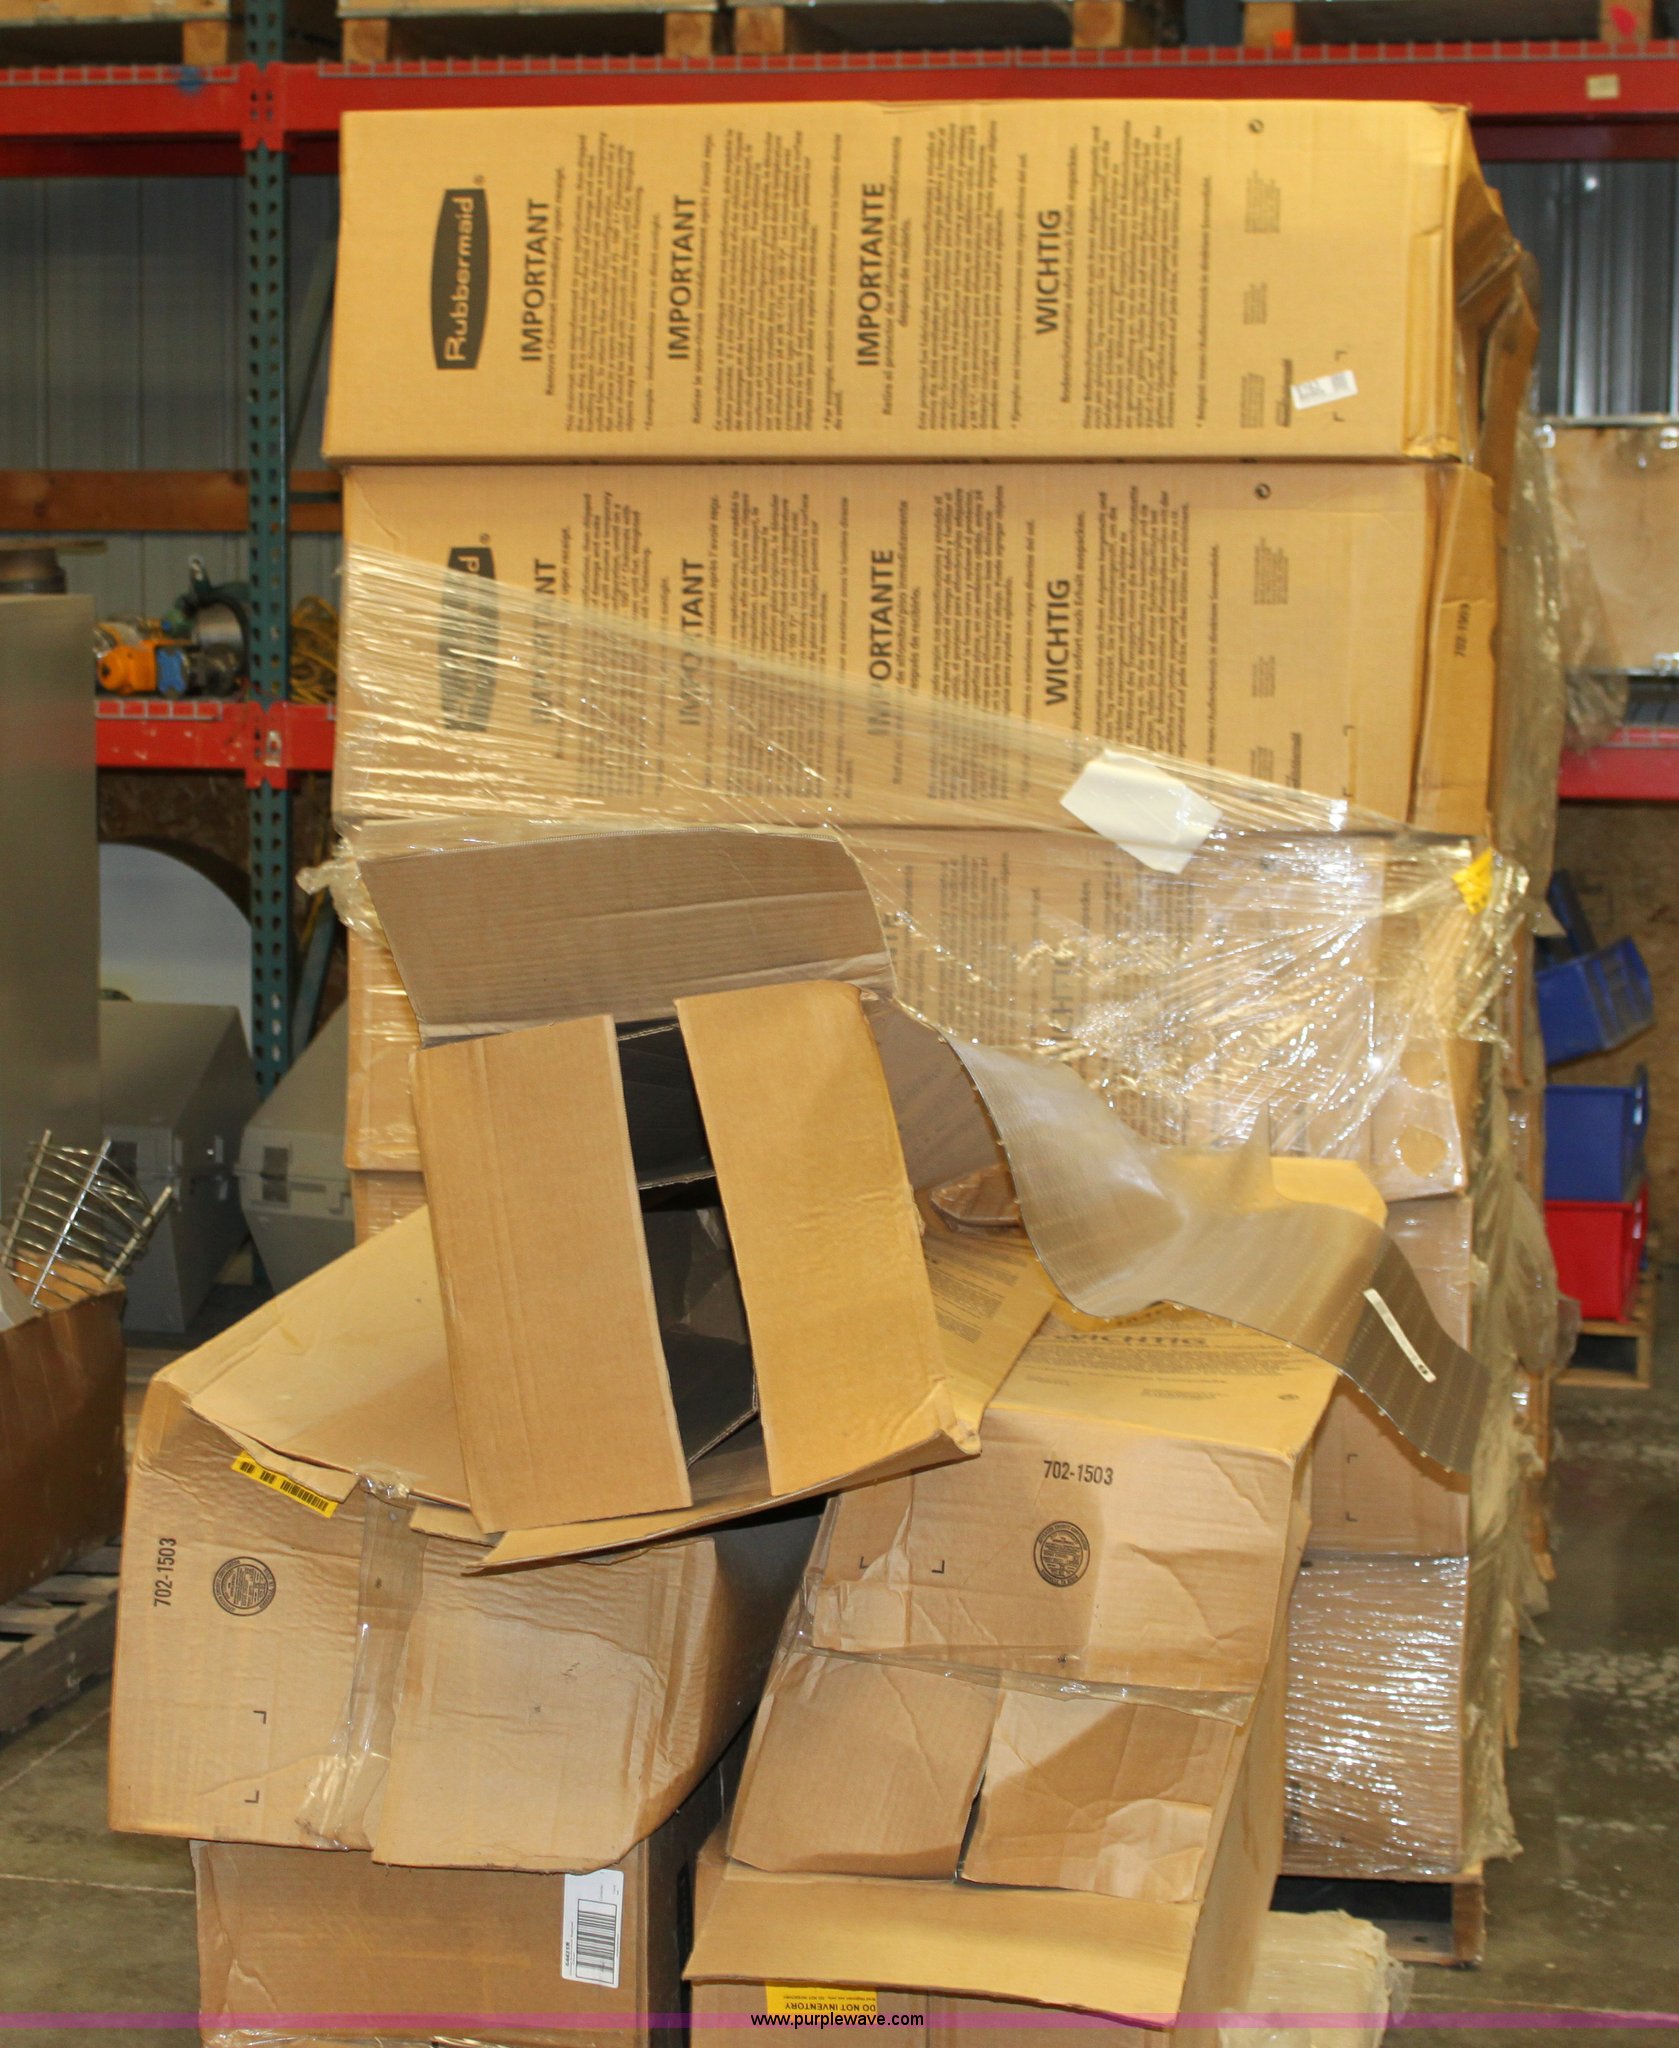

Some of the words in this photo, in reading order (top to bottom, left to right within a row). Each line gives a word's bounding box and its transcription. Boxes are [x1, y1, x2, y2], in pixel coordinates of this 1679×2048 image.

[443, 194, 475, 362] Rubbermaid
[520, 197, 550, 362] IMPORTANT
[668, 195, 696, 361] IMPORTANT
[856, 181, 886, 368] IMPORTANTE
[1034, 208, 1062, 336] WICHTIG
[679, 558, 705, 726] IMPOTANT
[867, 548, 894, 737] IMORTANTE
[1045, 578, 1071, 706] WICHTIG
[1043, 1460, 1114, 1486] 702-1503
[153, 1537, 177, 1608] 702-1503
[785, 2002, 839, 2011] INVENTORY
[841, 2003, 860, 2012] NOT
[862, 2003, 876, 2012] DO
